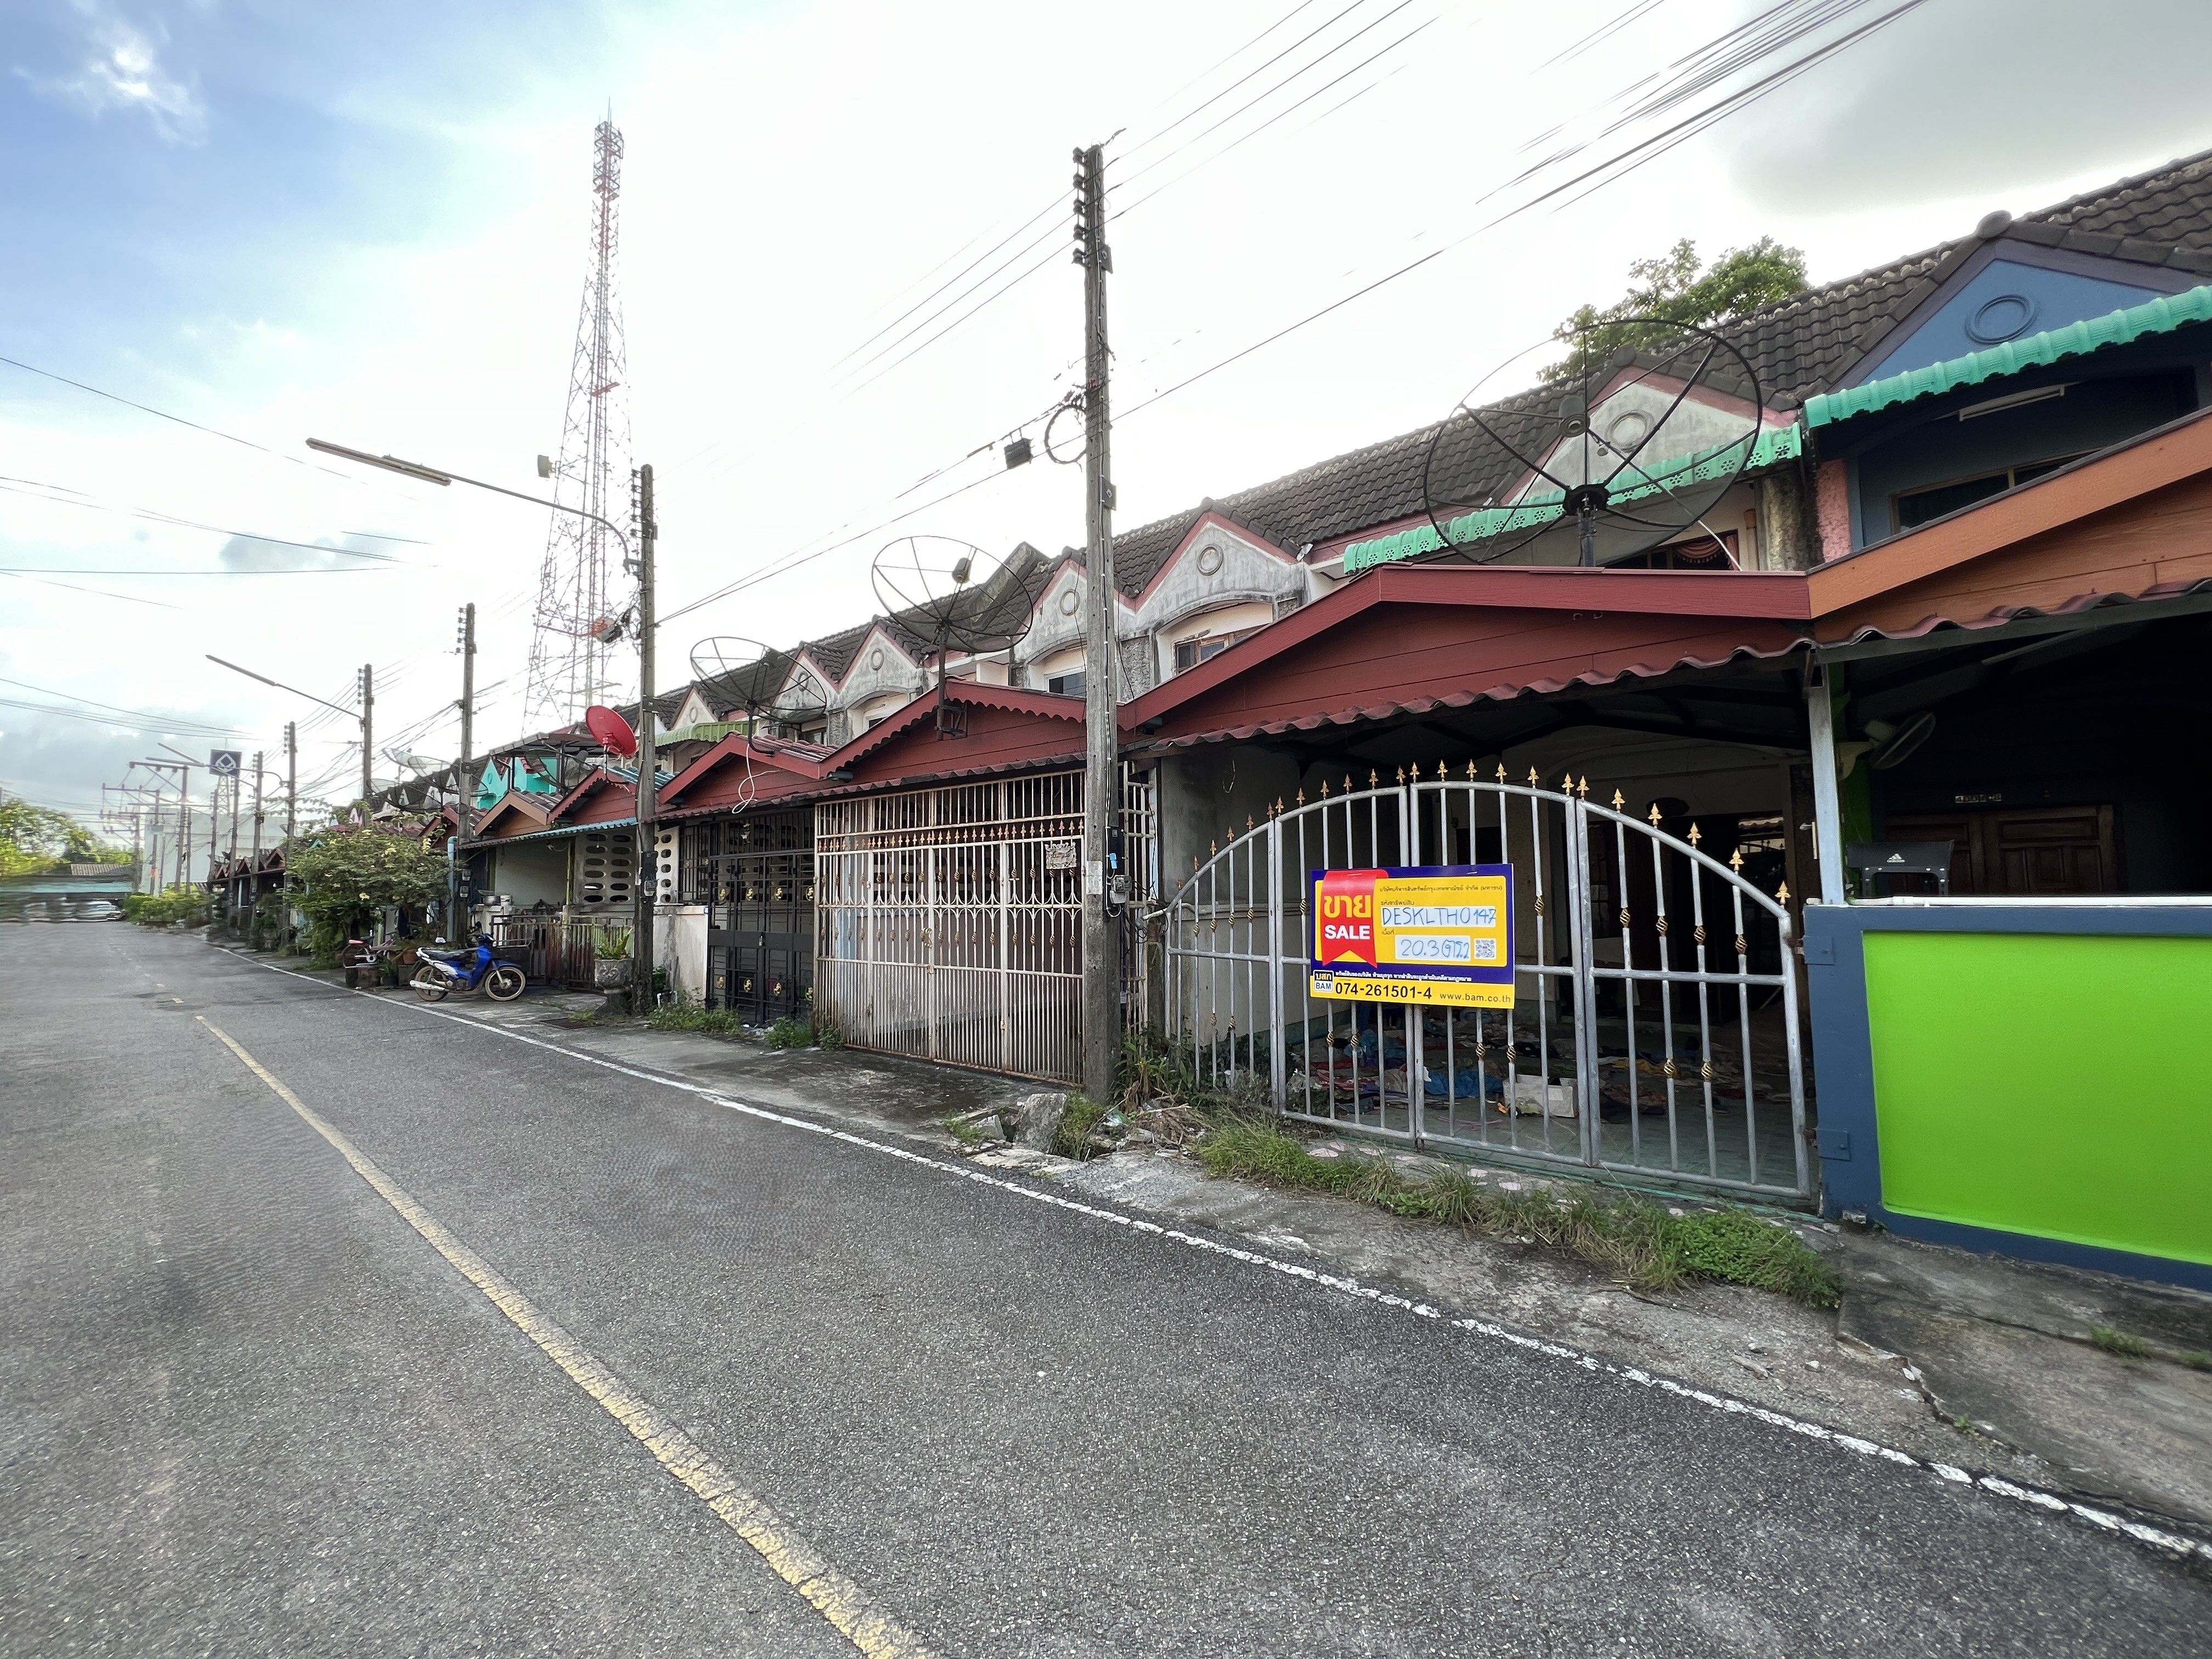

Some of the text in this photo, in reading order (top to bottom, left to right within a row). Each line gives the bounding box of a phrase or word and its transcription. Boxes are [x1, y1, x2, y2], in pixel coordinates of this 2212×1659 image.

[1324, 895, 1372, 918] ขาย
[1324, 924, 1371, 940] SALE
[1335, 983, 1511, 1003] 074-261501-4 www.bam.co.th
